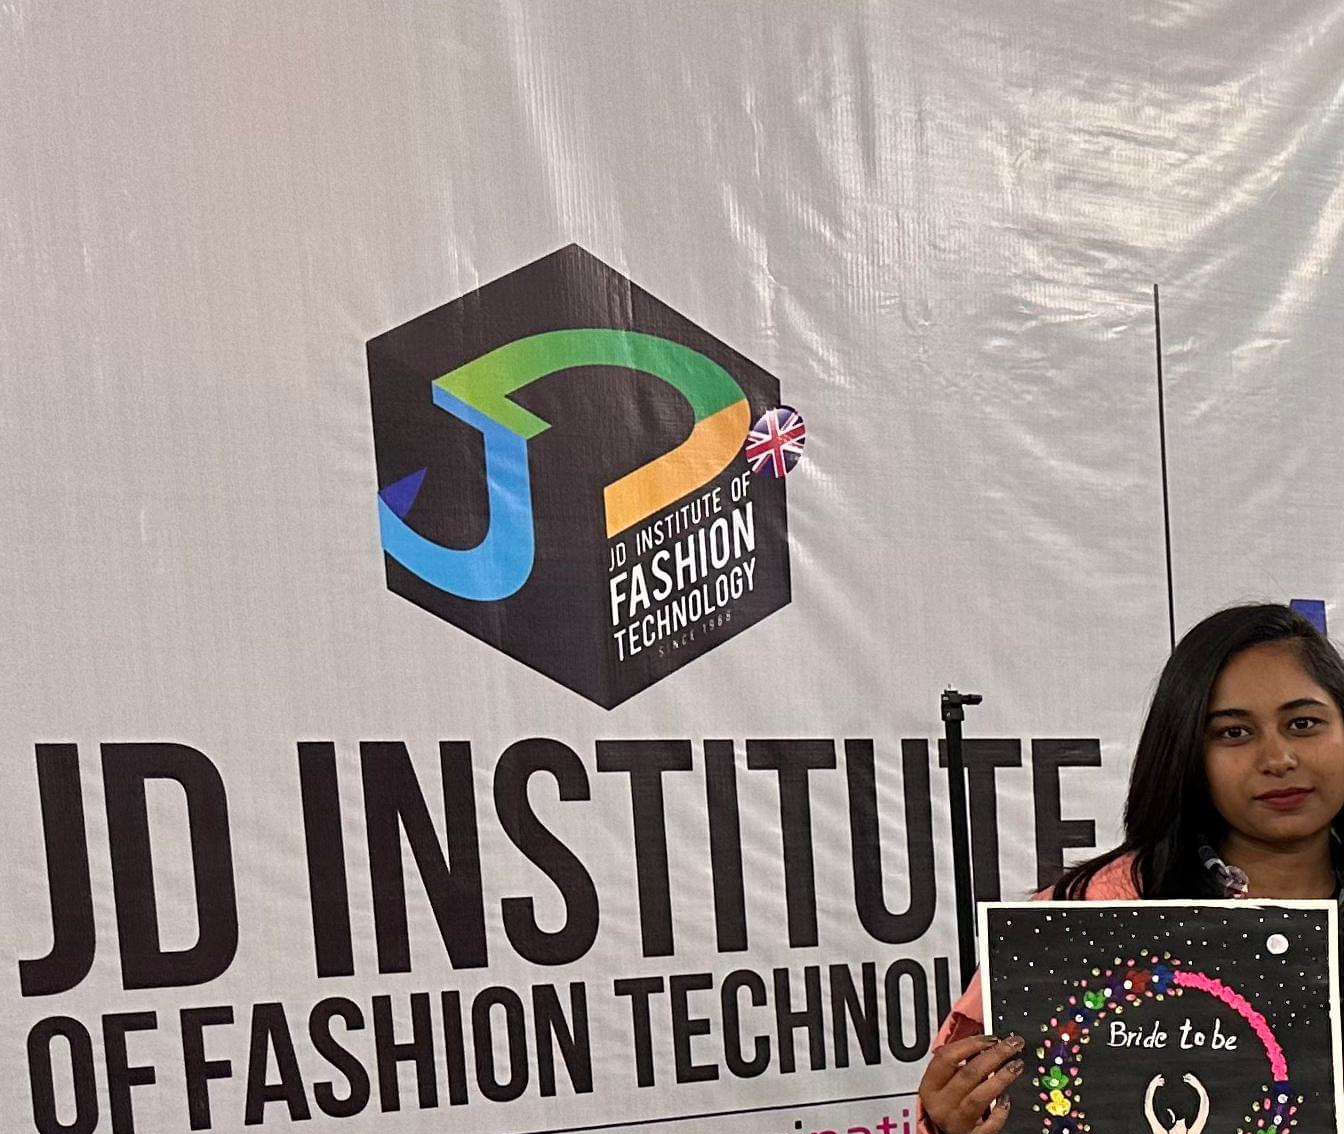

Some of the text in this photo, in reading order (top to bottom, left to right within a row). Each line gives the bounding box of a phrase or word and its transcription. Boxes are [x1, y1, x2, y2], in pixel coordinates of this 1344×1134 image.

[608, 470, 751, 573] JD INSTITUTE OF
[609, 501, 756, 627] FASHION
[613, 556, 757, 662] TECHNOLOGY
[18, 738, 1102, 996] JD INSTITUTE
[182, 983, 594, 1133] FASHION
[1107, 1017, 1238, 1050] Bride to be
